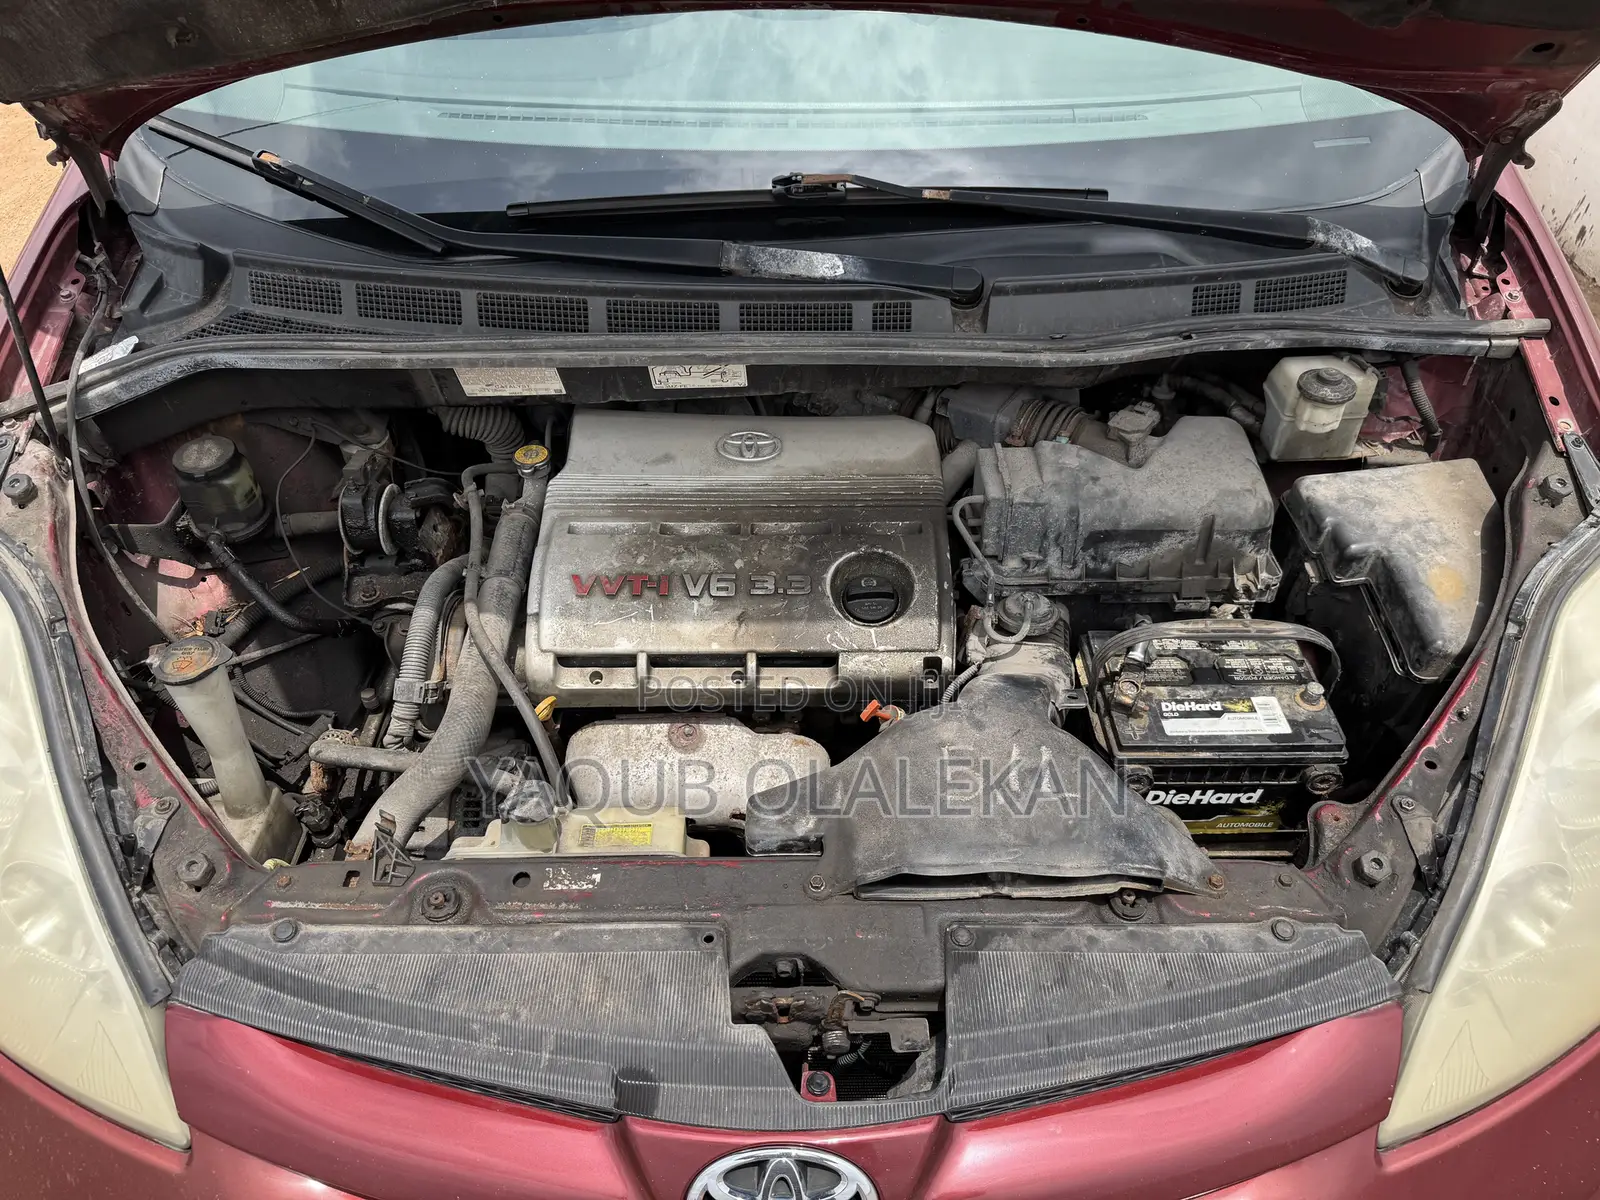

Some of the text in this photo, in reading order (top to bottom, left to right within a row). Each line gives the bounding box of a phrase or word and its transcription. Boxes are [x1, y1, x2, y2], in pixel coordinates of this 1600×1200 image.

[682, 573, 737, 597] V6
[749, 575, 812, 596] 3.3
[1160, 701, 1223, 713] DieHard
[1145, 788, 1265, 806] DieHard
